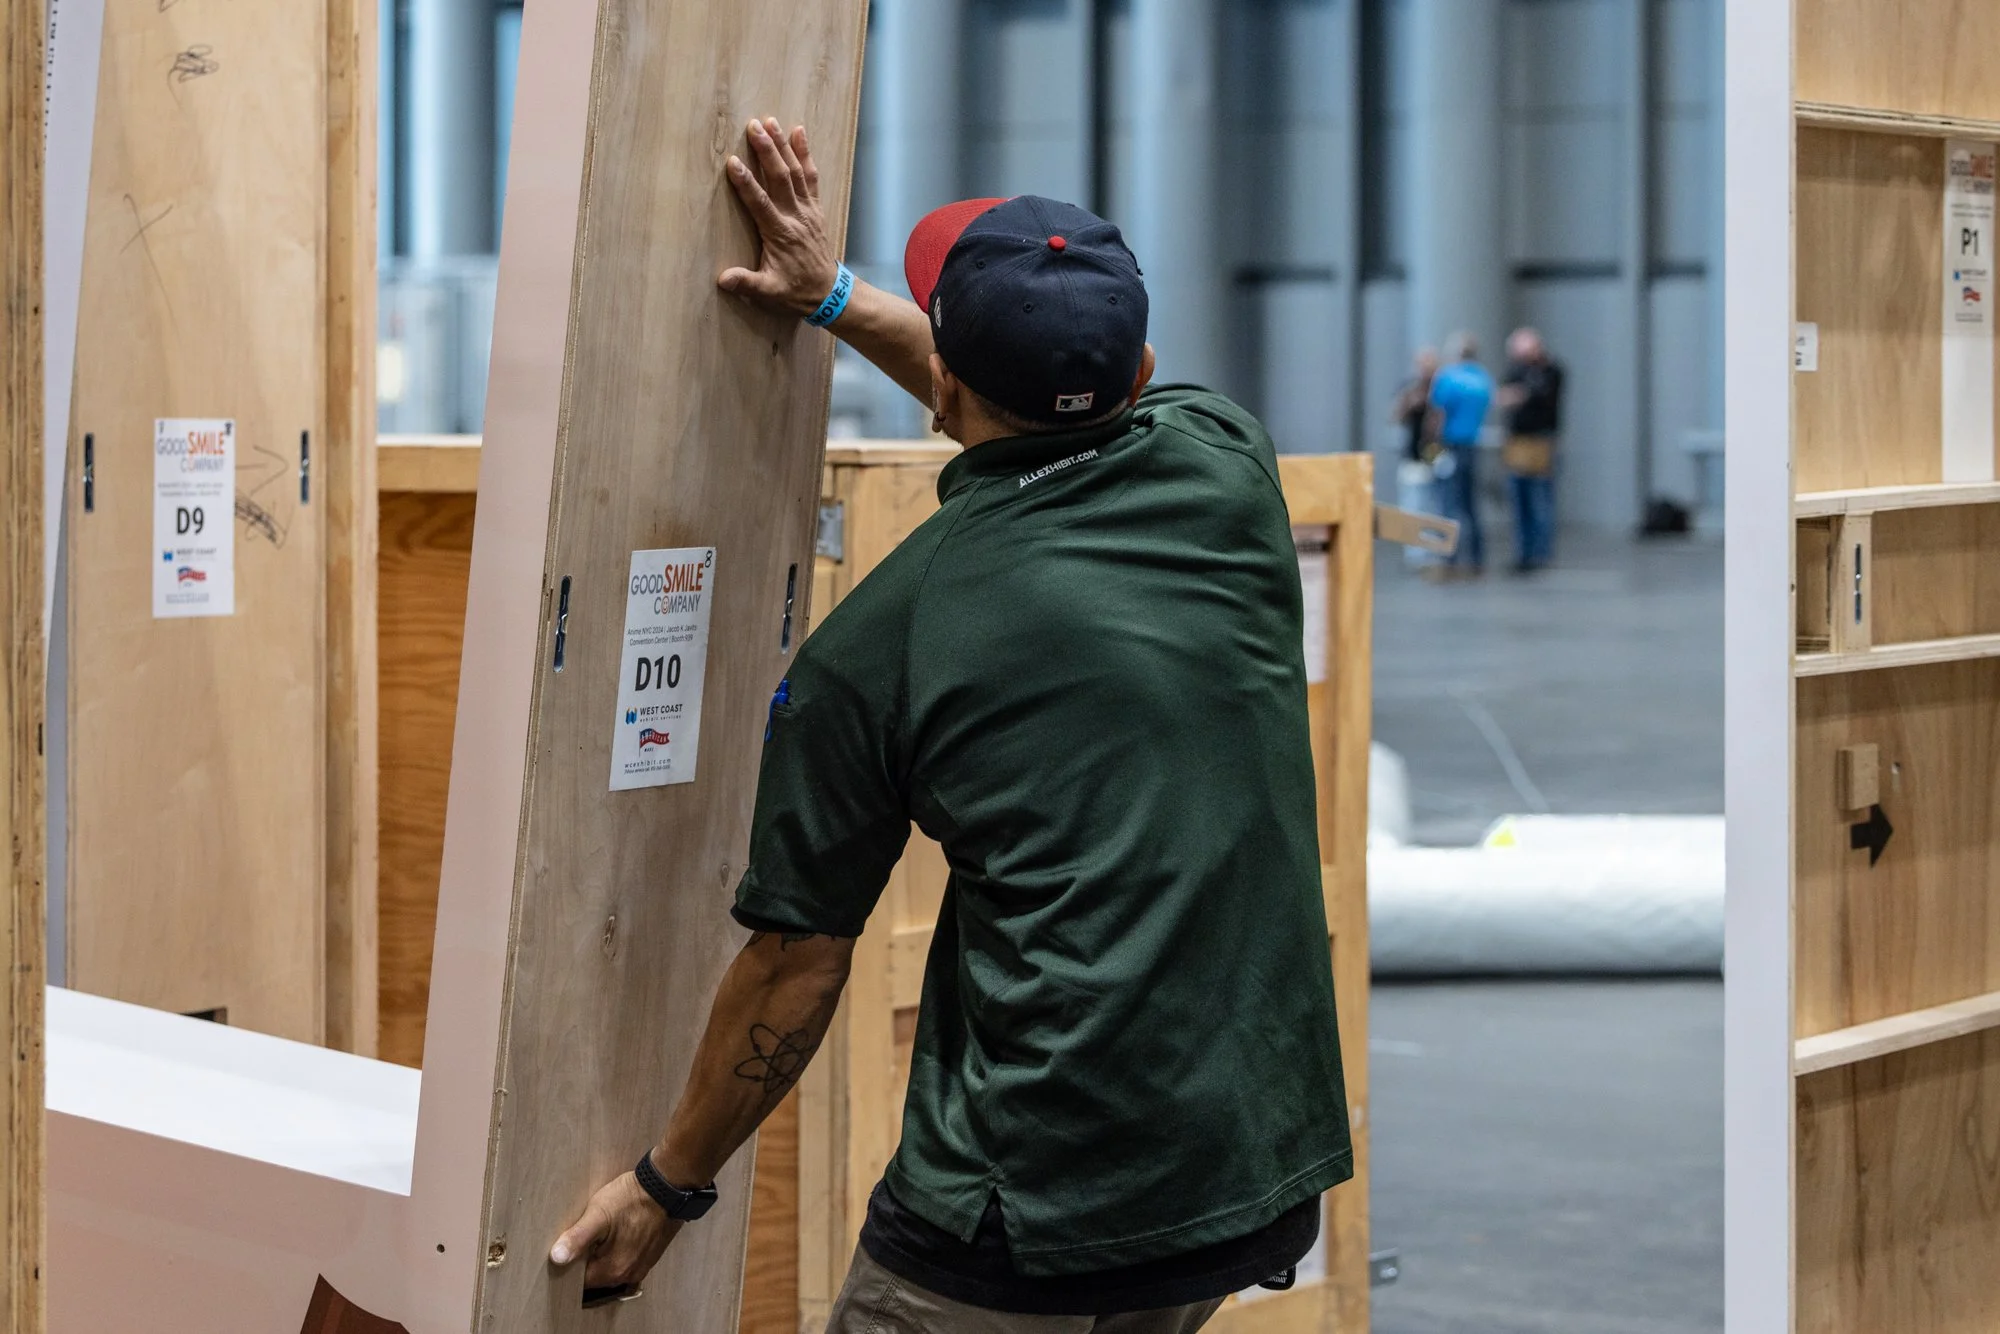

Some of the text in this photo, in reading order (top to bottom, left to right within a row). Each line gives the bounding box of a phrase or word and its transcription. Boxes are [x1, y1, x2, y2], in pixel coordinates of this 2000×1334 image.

[1961, 226, 1978, 256] P1
[157, 431, 225, 456] GOOD SMILE
[1019, 448, 1099, 489] ALLEXHIBIT.COM
[176, 506, 205, 535] D9
[704, 550, 713, 568] 8
[631, 562, 705, 596] GOOD SMILE
[654, 594, 702, 615] COMPANY
[630, 637, 654, 647] Convention
[635, 654, 682, 692] D10
[640, 703, 683, 716] WEST COAST
